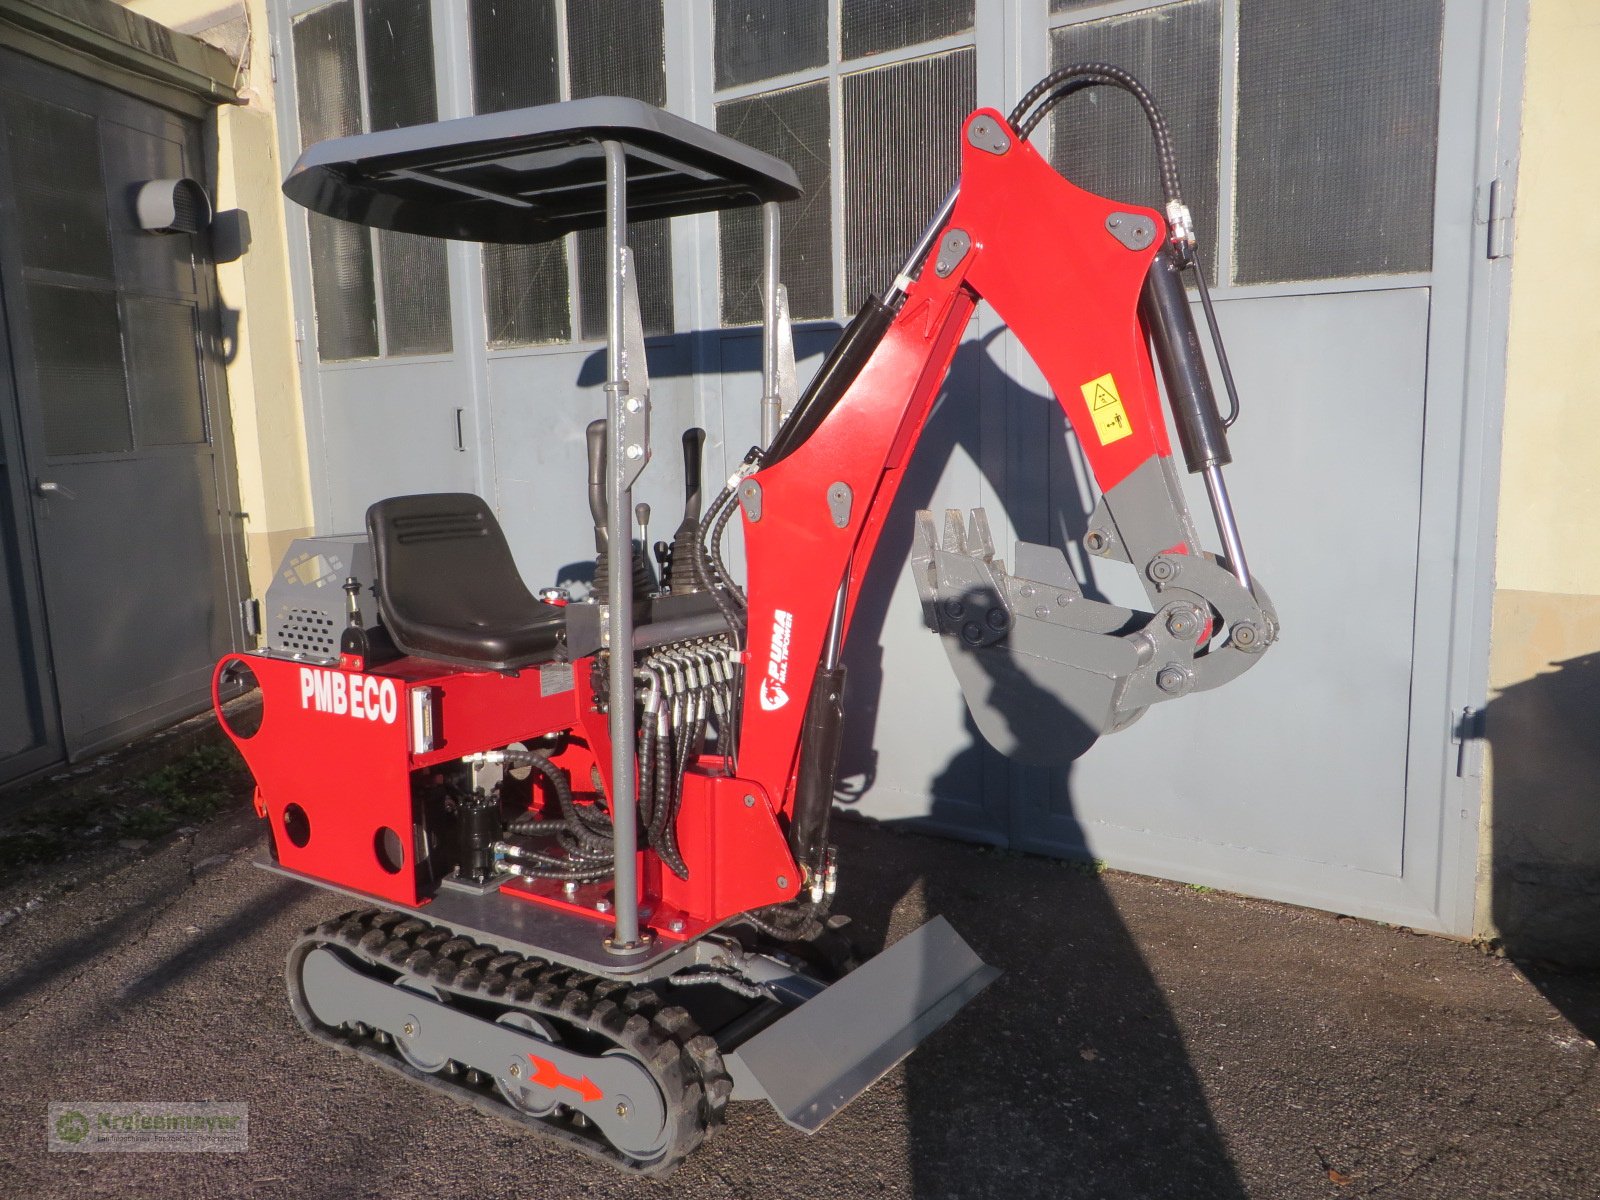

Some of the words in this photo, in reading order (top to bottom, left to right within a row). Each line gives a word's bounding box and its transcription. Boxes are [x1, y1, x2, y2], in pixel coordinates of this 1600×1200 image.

[768, 609, 788, 680] PUMA
[778, 612, 793, 684] MULTIPOWER
[300, 667, 348, 715] PMB
[350, 674, 397, 724] ECO
